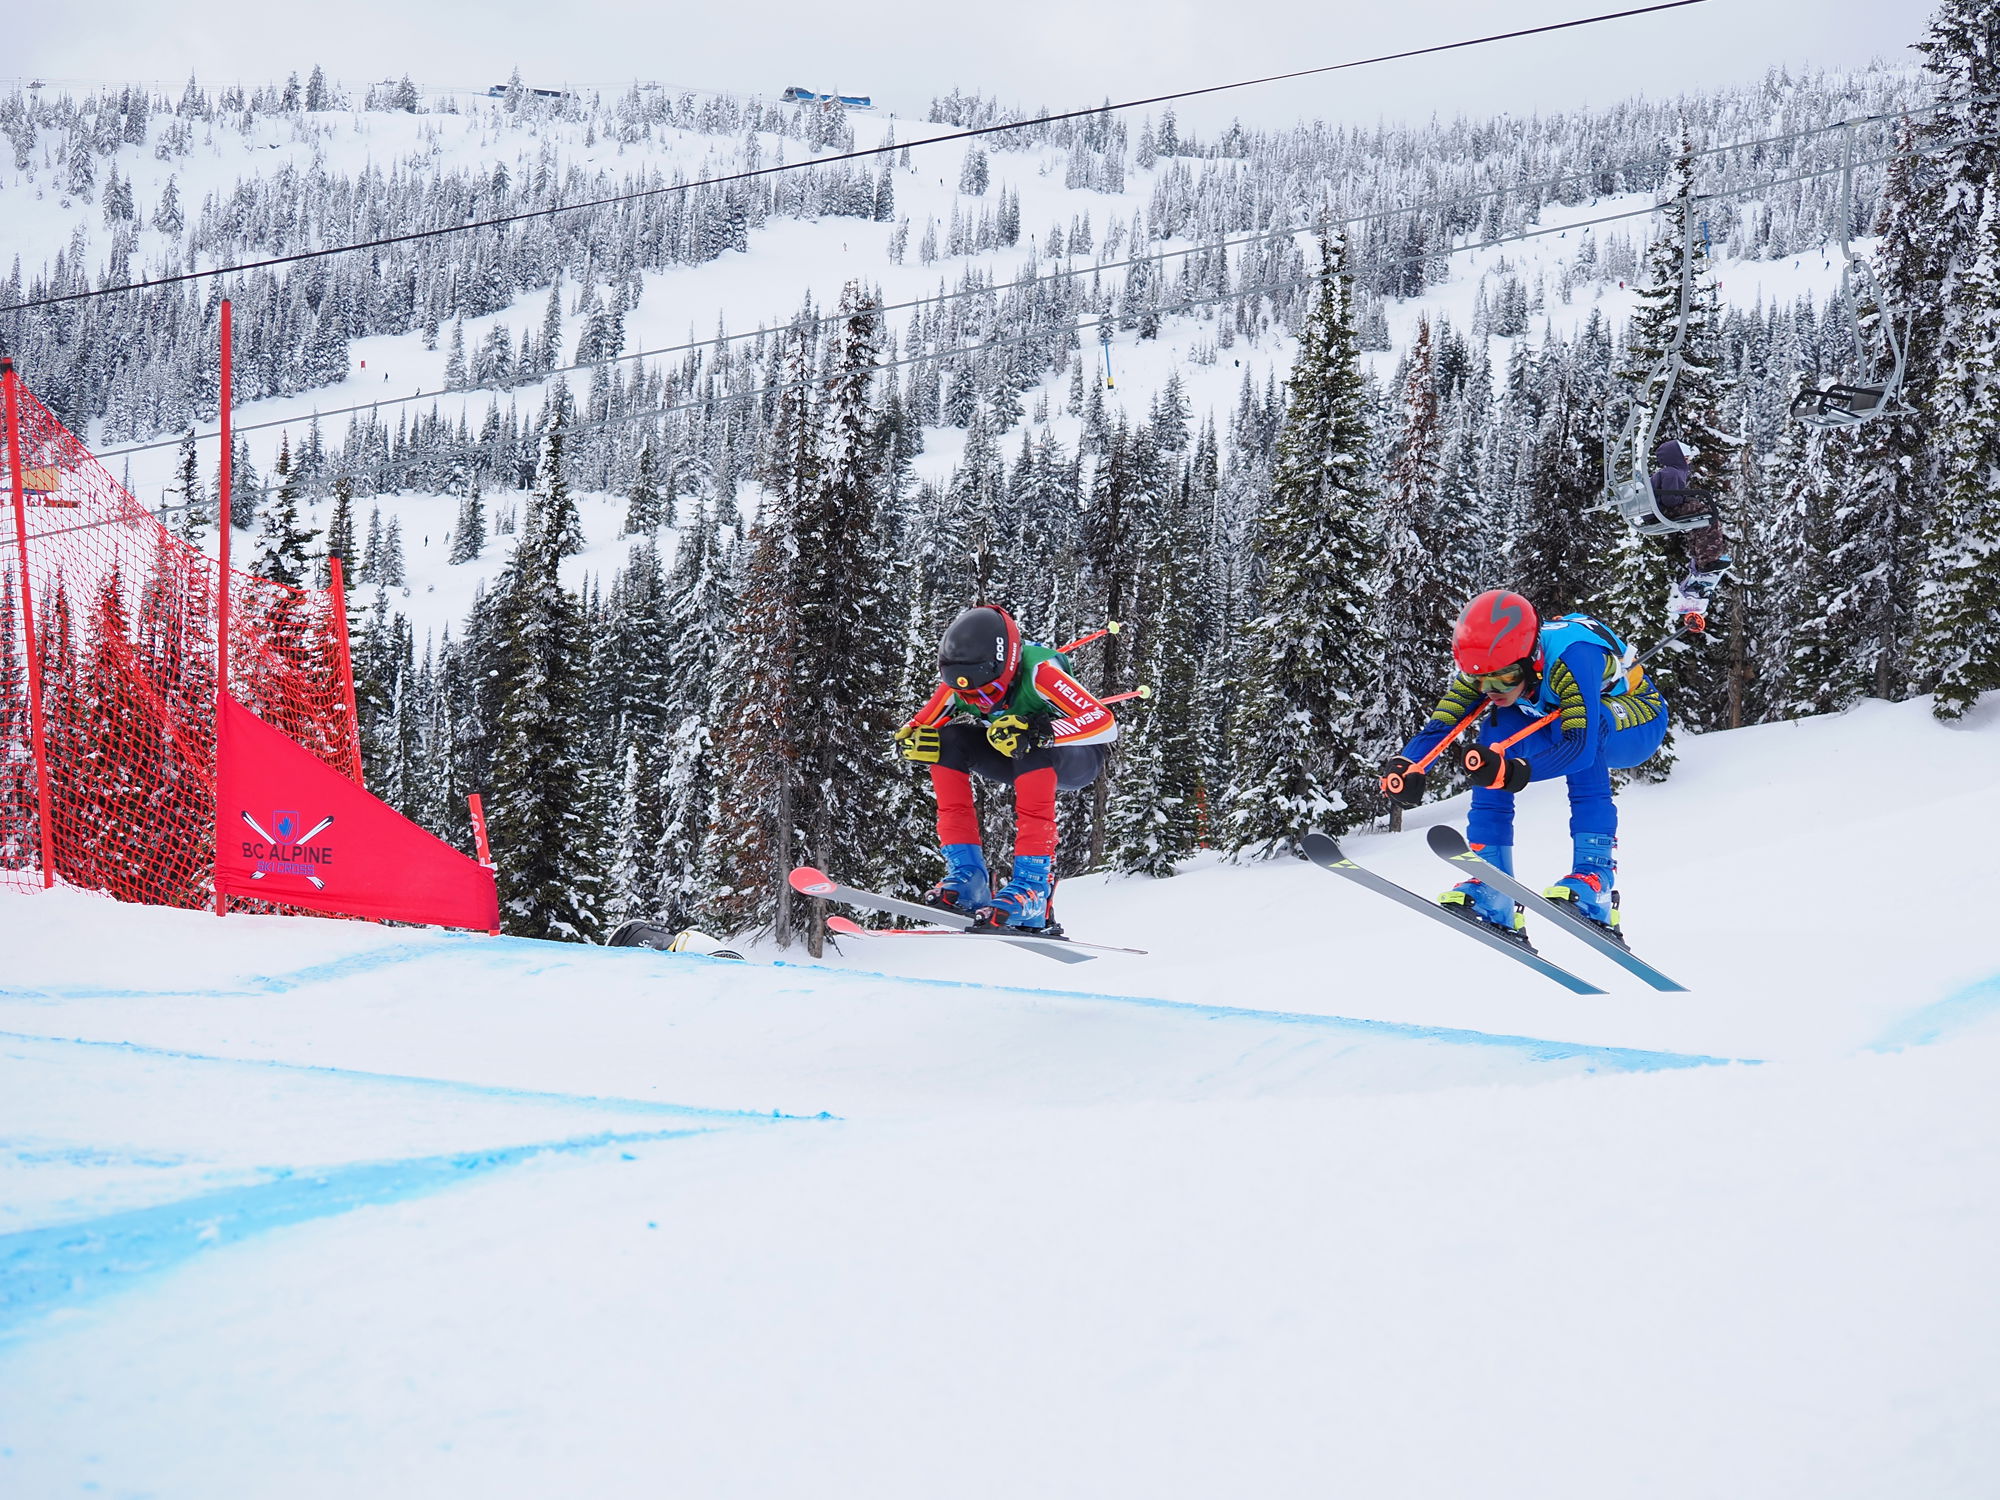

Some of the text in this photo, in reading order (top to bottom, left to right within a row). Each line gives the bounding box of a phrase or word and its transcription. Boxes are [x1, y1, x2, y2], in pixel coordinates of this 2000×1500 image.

[1053, 679, 1094, 710] HELLY
[242, 842, 332, 865] BC ALPINE
[257, 861, 315, 876] SKI CROSS
